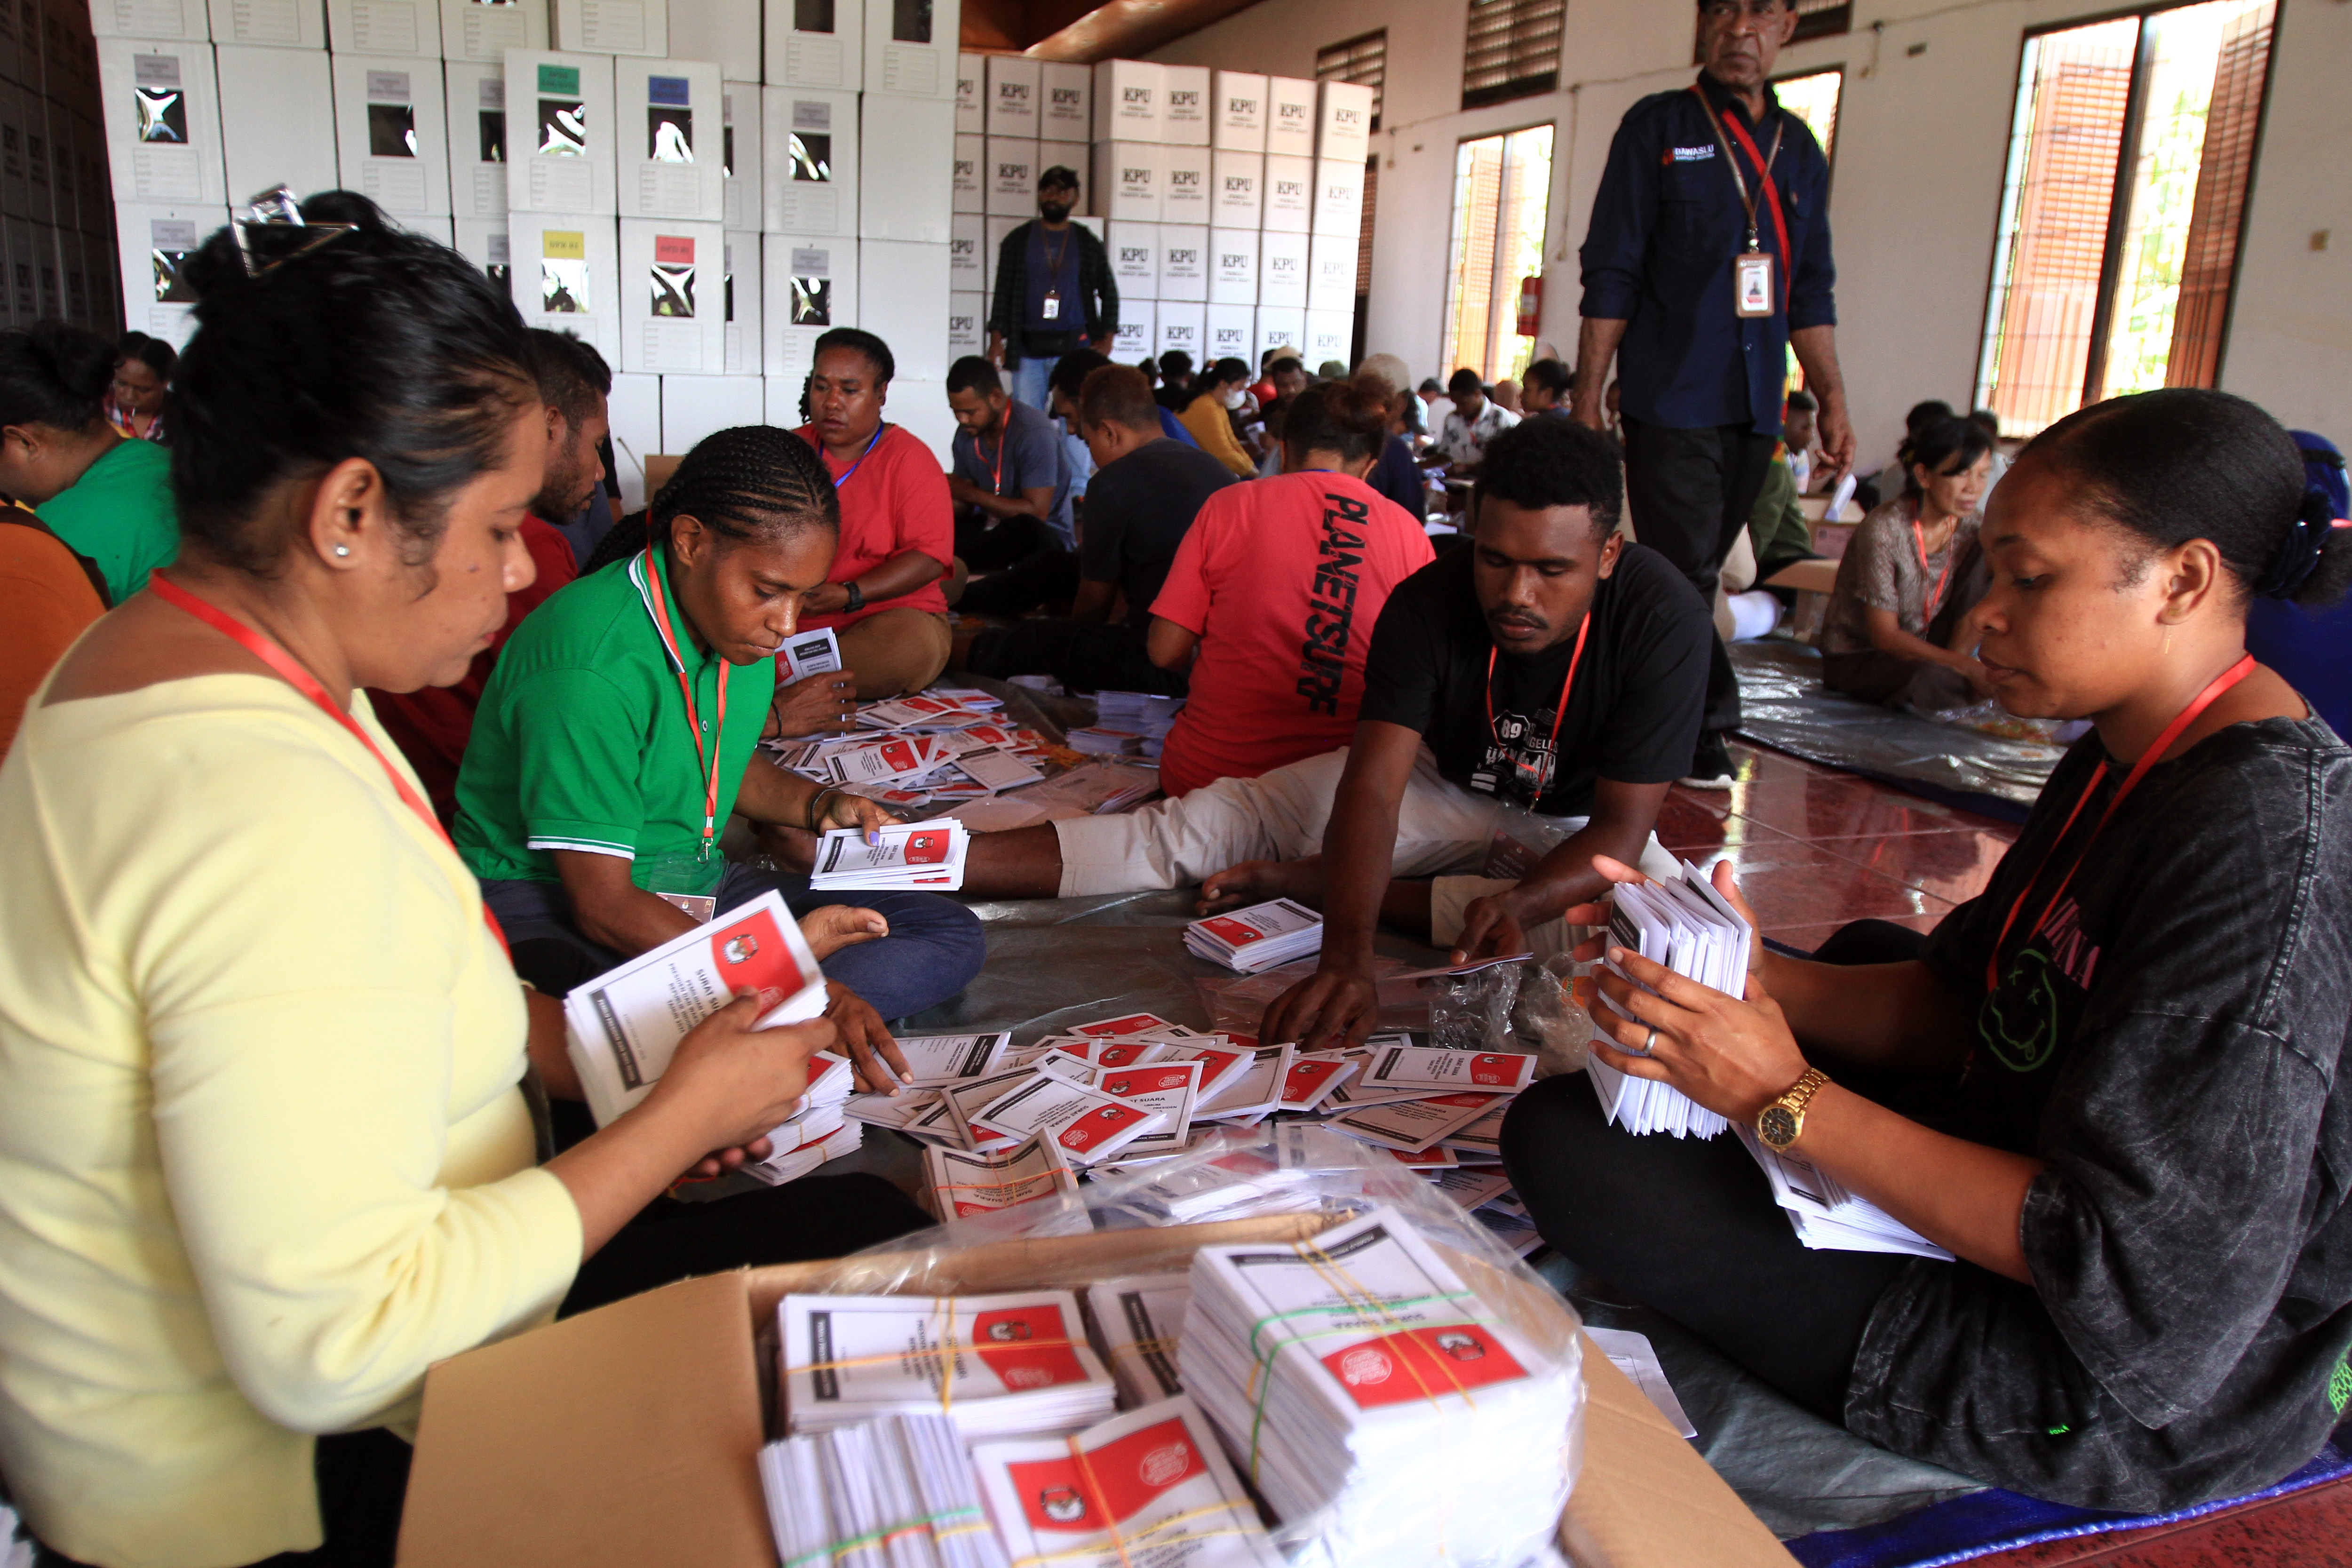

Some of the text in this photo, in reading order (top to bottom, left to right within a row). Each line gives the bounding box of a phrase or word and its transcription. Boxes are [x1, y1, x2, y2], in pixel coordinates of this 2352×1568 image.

[958, 79, 973, 94] PU
[1001, 82, 1030, 98] KPU
[1052, 88, 1081, 103] KPU
[1123, 87, 1151, 102] KPU
[1170, 90, 1198, 104] KPU
[1230, 97, 1256, 113] KPU
[1280, 103, 1307, 118] KPU
[1335, 108, 1360, 123] KPU
[999, 164, 1028, 179] KPU
[1123, 168, 1151, 184] KPU
[1172, 171, 1200, 186] KPU
[1225, 176, 1252, 192] KPU
[1277, 181, 1303, 196] KPU
[1329, 186, 1354, 201] KPU
[1120, 247, 1148, 262] KPU
[1169, 248, 1197, 263] KPU
[1223, 254, 1248, 269] KPU
[1272, 257, 1298, 271] KPU
[1323, 261, 1348, 277] KPU
[1167, 326, 1193, 340] KPU
[1217, 328, 1243, 343] KPU
[1268, 331, 1294, 346] KPU
[1317, 334, 1342, 348] KPU
[1297, 493, 1368, 716] PLANETSURF
[1501, 719, 1522, 739] 89
[668, 963, 686, 993] PRESIDEN
[695, 968, 714, 996] SURAT
[667, 982, 684, 1010] REPUBLIK
[1049, 1104, 1089, 1129] SURAT SUARA
[973, 1194, 1002, 1202] SUARA
